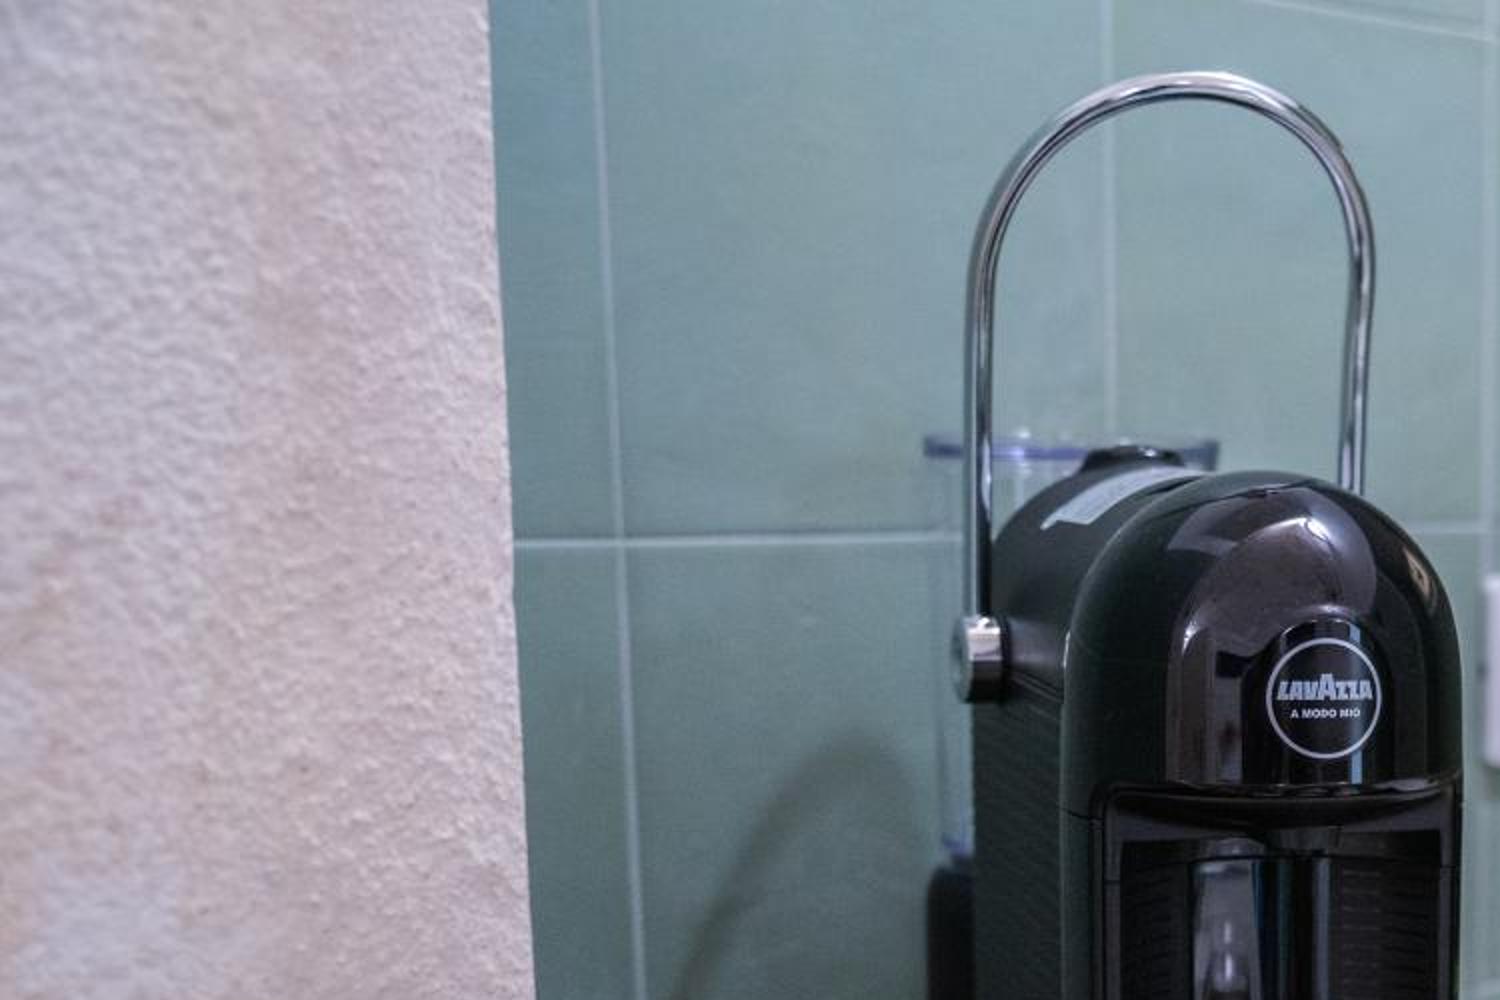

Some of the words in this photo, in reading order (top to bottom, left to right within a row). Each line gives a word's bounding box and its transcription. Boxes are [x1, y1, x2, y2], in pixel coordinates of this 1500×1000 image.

[1277, 673, 1373, 701] LAVAZZA
[1290, 708, 1299, 719] A
[1301, 708, 1337, 719] MODO
